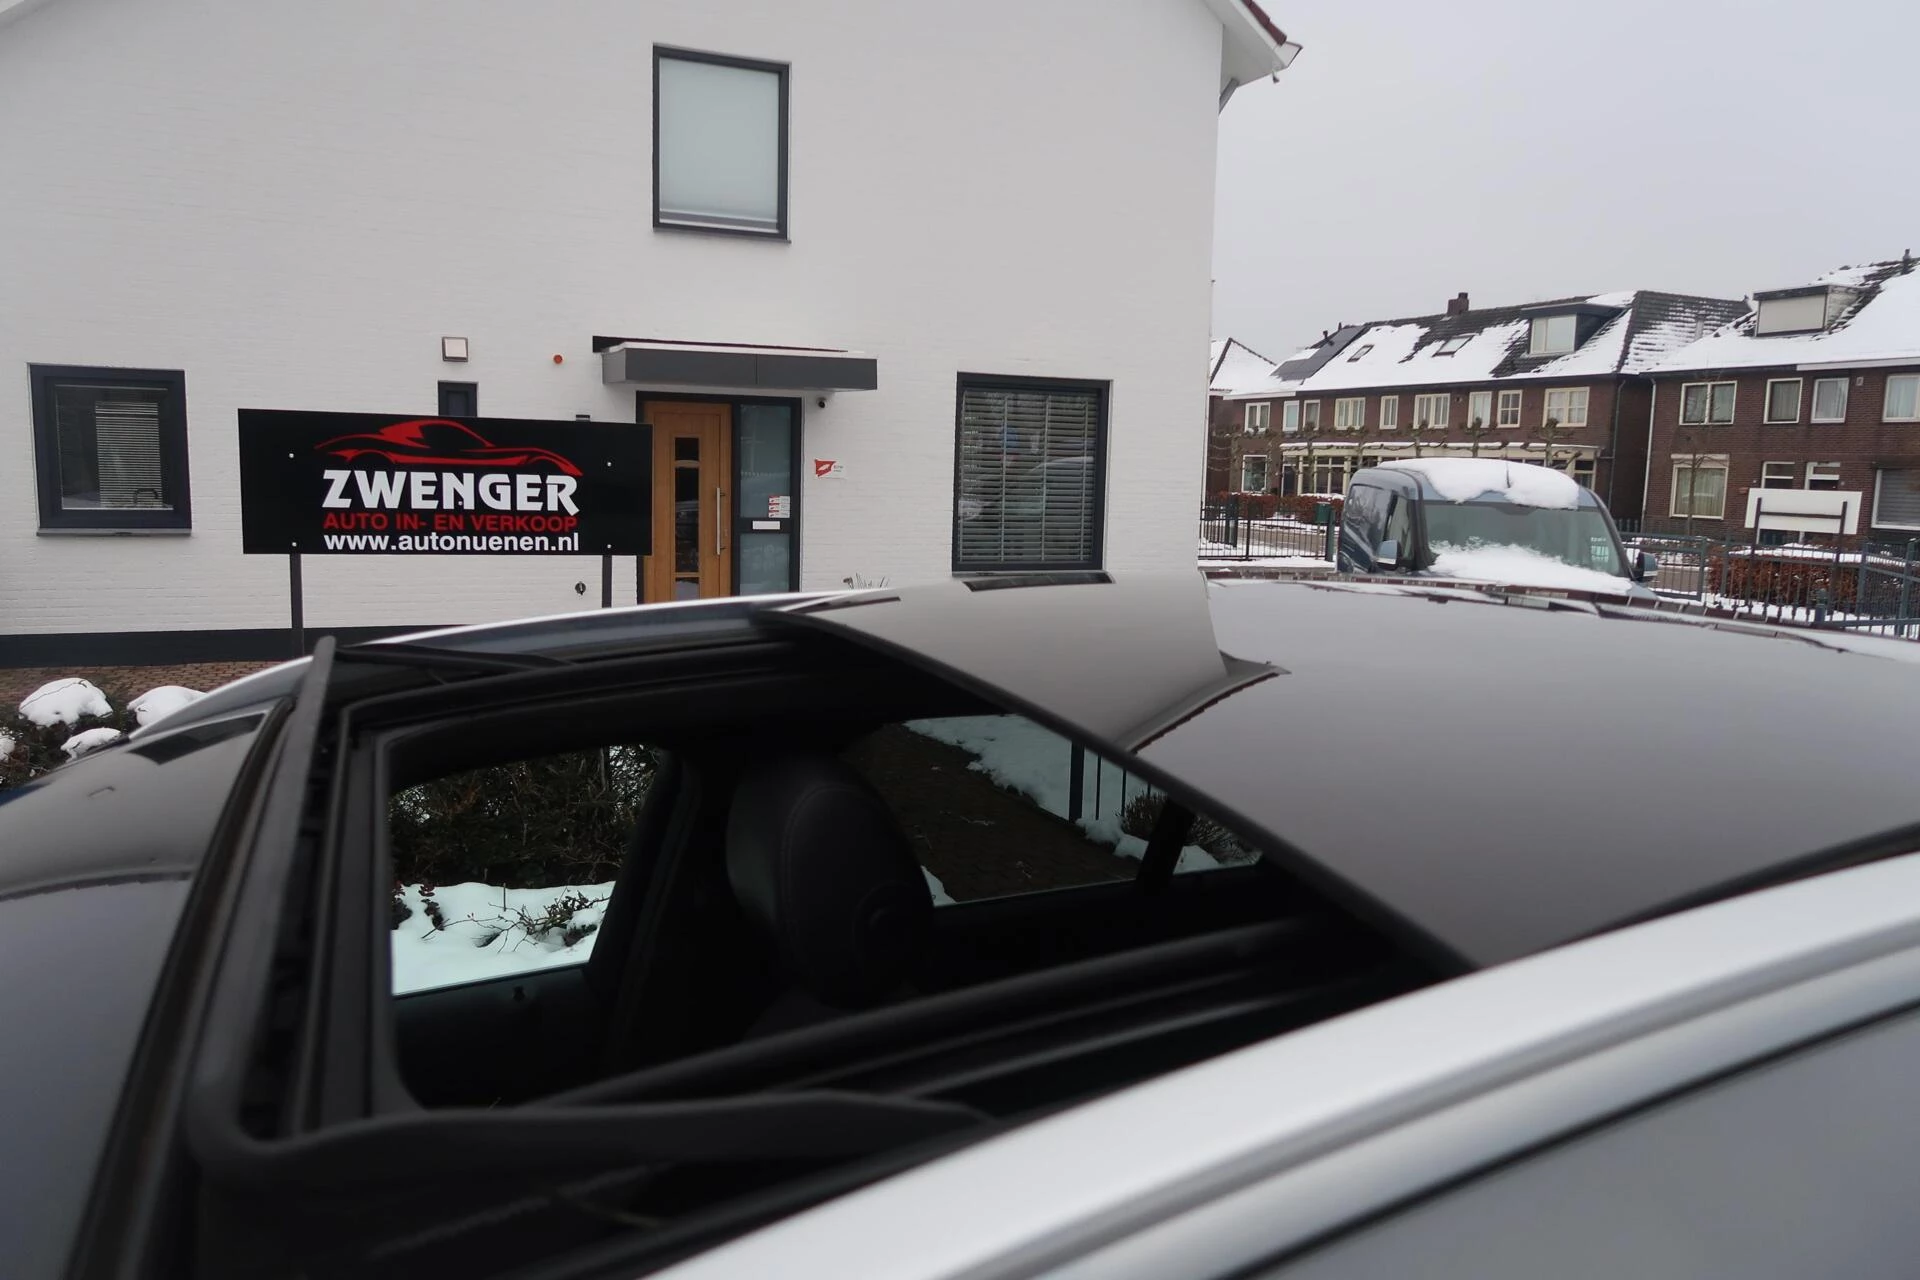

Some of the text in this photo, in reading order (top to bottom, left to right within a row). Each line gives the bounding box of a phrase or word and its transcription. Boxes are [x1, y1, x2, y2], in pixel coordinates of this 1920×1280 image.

[321, 469, 580, 516] ZWENGER
[323, 512, 577, 532] AUTO IN- EN VERKOOP
[323, 532, 580, 551] www.autonuenen.nl
